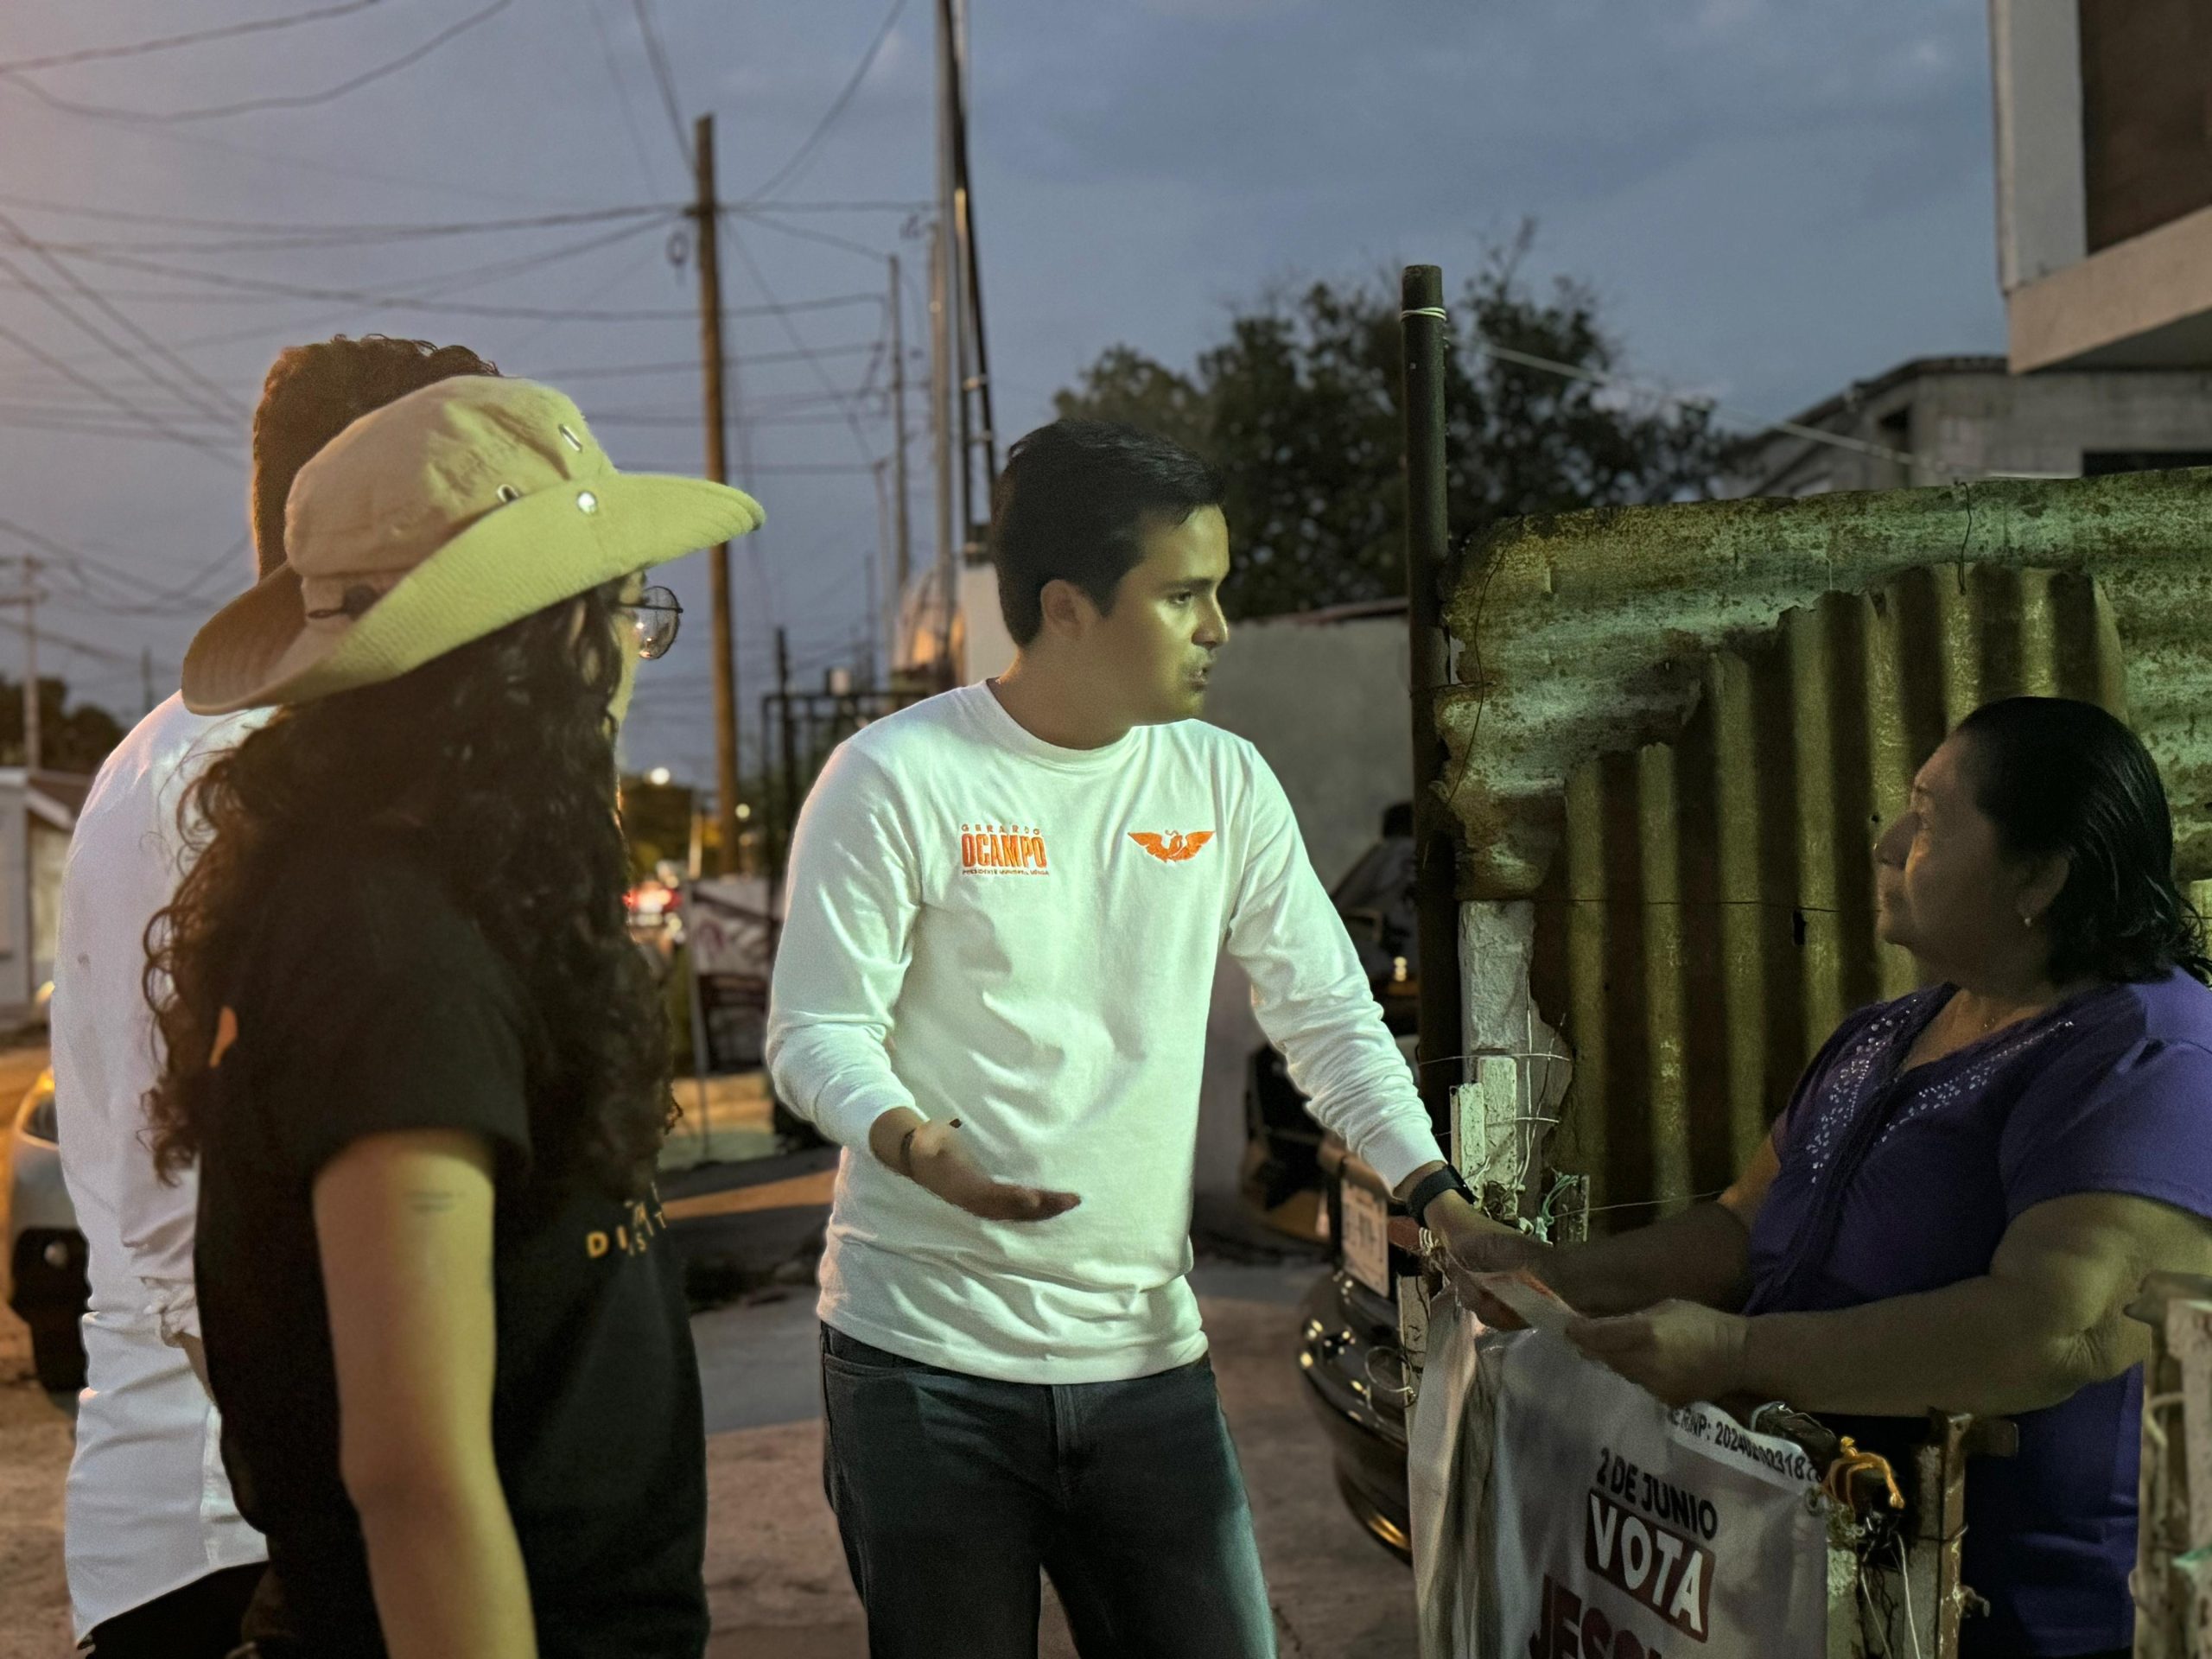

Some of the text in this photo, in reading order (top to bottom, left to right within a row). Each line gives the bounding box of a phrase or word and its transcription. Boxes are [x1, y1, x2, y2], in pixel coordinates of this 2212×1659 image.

[961, 824, 1039, 835] GERARDO
[962, 834, 1047, 868] OCAMPO
[1597, 1446, 1719, 1541] 2 DE JUNIO
[1590, 1493, 1704, 1634] VOTA
